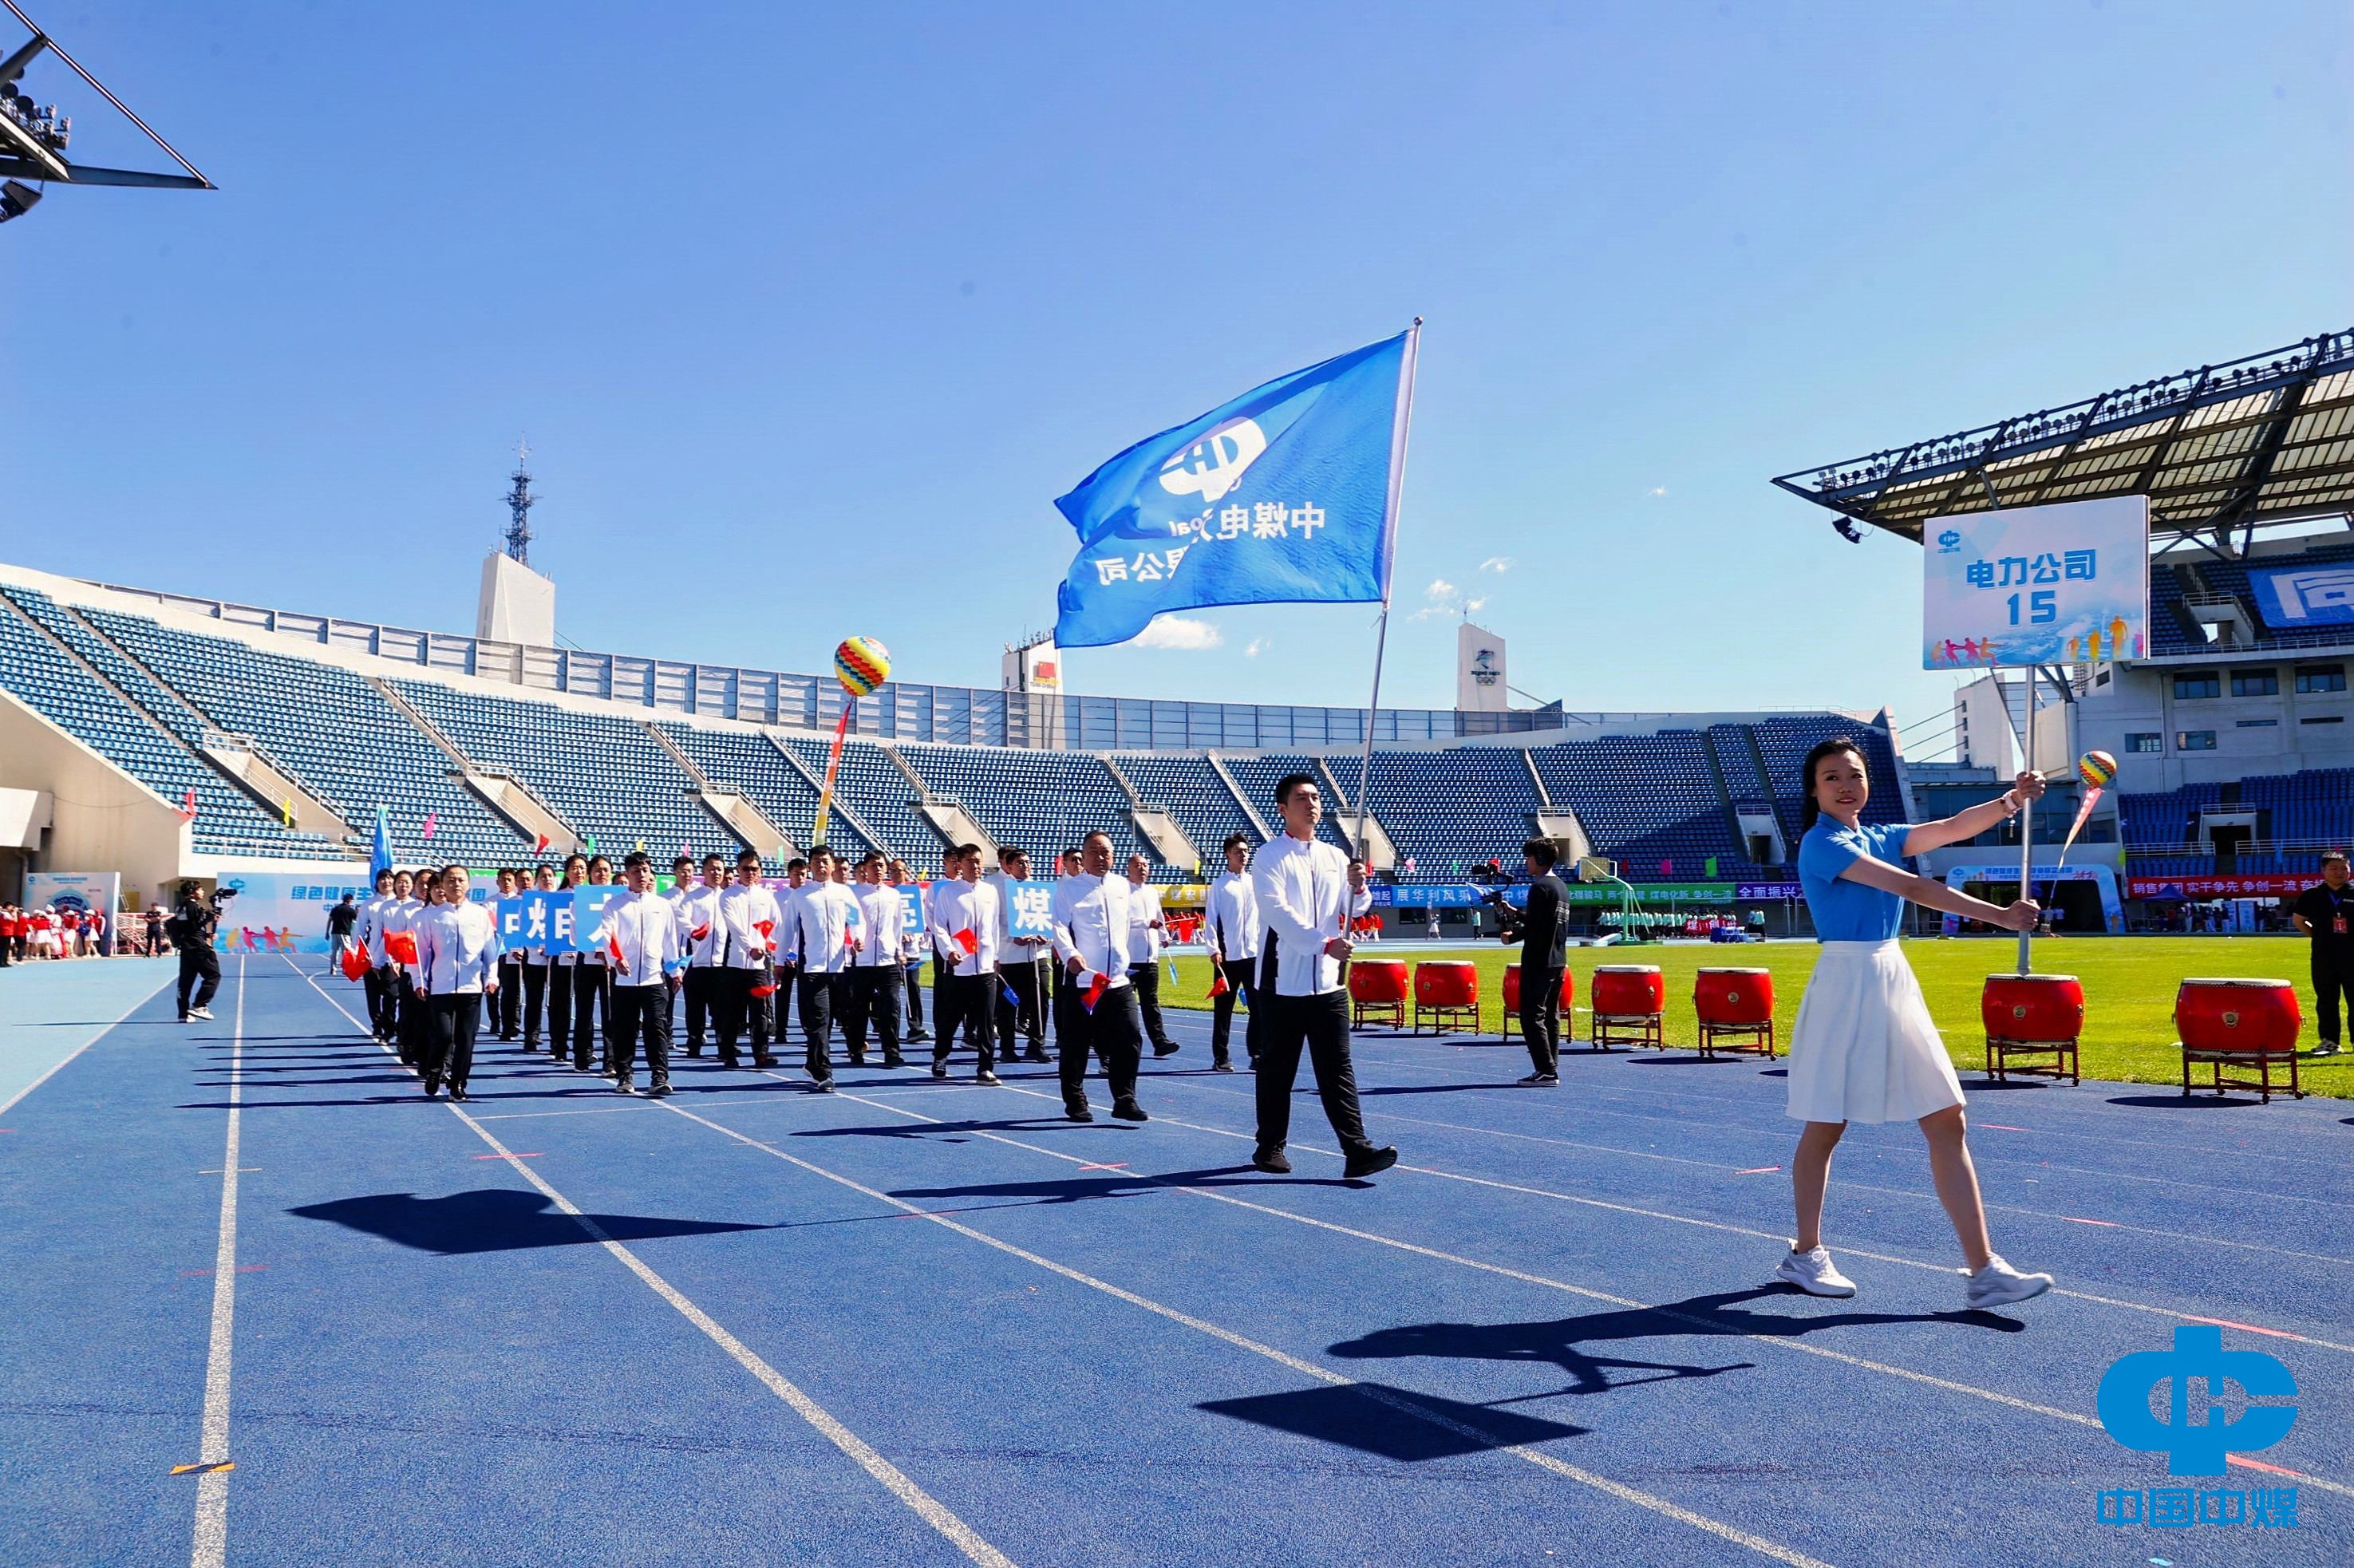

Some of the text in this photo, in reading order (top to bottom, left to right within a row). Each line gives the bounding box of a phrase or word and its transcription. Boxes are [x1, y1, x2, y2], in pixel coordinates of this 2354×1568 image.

[1966, 548, 2096, 589] 电力公司
[2007, 590, 2056, 626] 15
[2241, 879, 2297, 891] 争创一流
[1012, 887, 1053, 932] 煤
